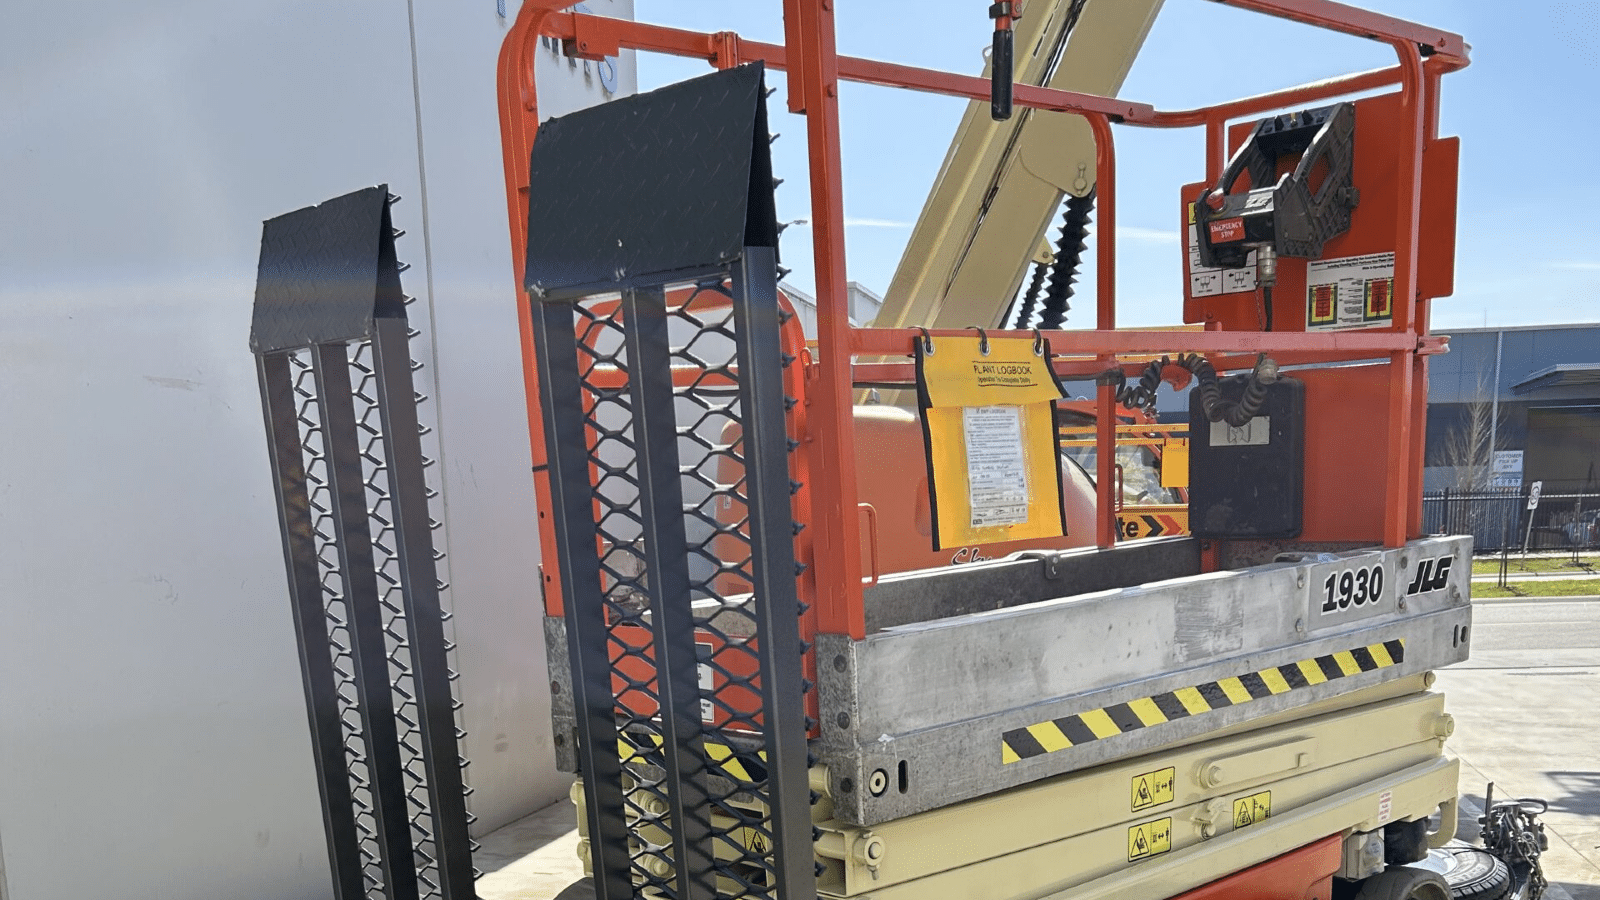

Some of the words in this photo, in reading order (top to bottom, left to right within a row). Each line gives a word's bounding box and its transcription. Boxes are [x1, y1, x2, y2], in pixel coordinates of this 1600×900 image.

[1210, 221, 1242, 233] EMERGENCY
[1221, 231, 1235, 239] STOP
[973, 365, 995, 374] PLANT
[996, 366, 1033, 375] LOGBOOK
[1407, 555, 1454, 597] JLG
[1321, 564, 1384, 614] 1930
